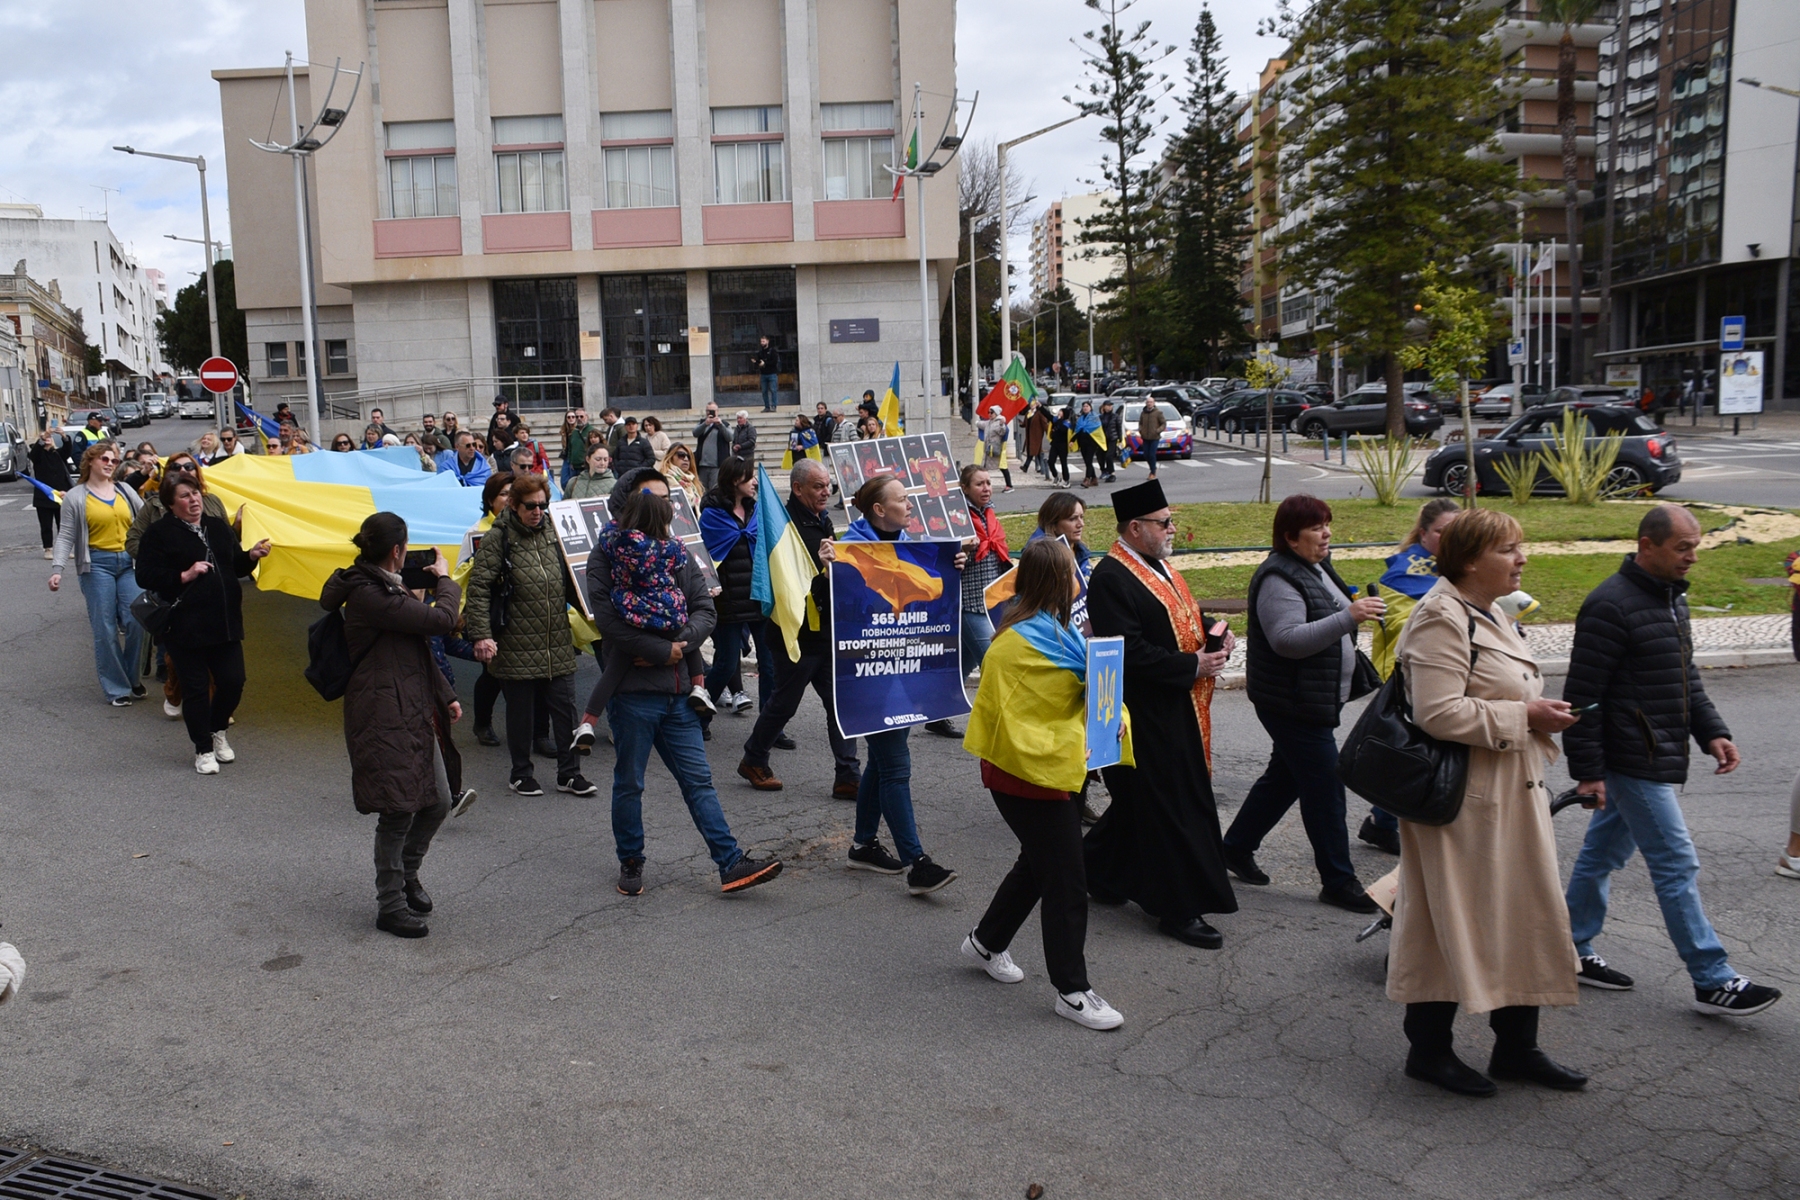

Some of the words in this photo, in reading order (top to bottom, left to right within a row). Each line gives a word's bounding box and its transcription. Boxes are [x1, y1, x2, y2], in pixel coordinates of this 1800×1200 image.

[871, 613, 895, 625] 365
[897, 611, 928, 626] ДНІВ
[862, 624, 951, 638] ПОВНОМАСШТАБНОГО
[838, 637, 906, 651] ВТОРГНЕННЯ
[870, 650, 876, 659] 9
[878, 648, 905, 659] РОКІВ
[906, 641, 944, 658] ВІЙНИ
[855, 657, 921, 677] УКРАЇНИ
